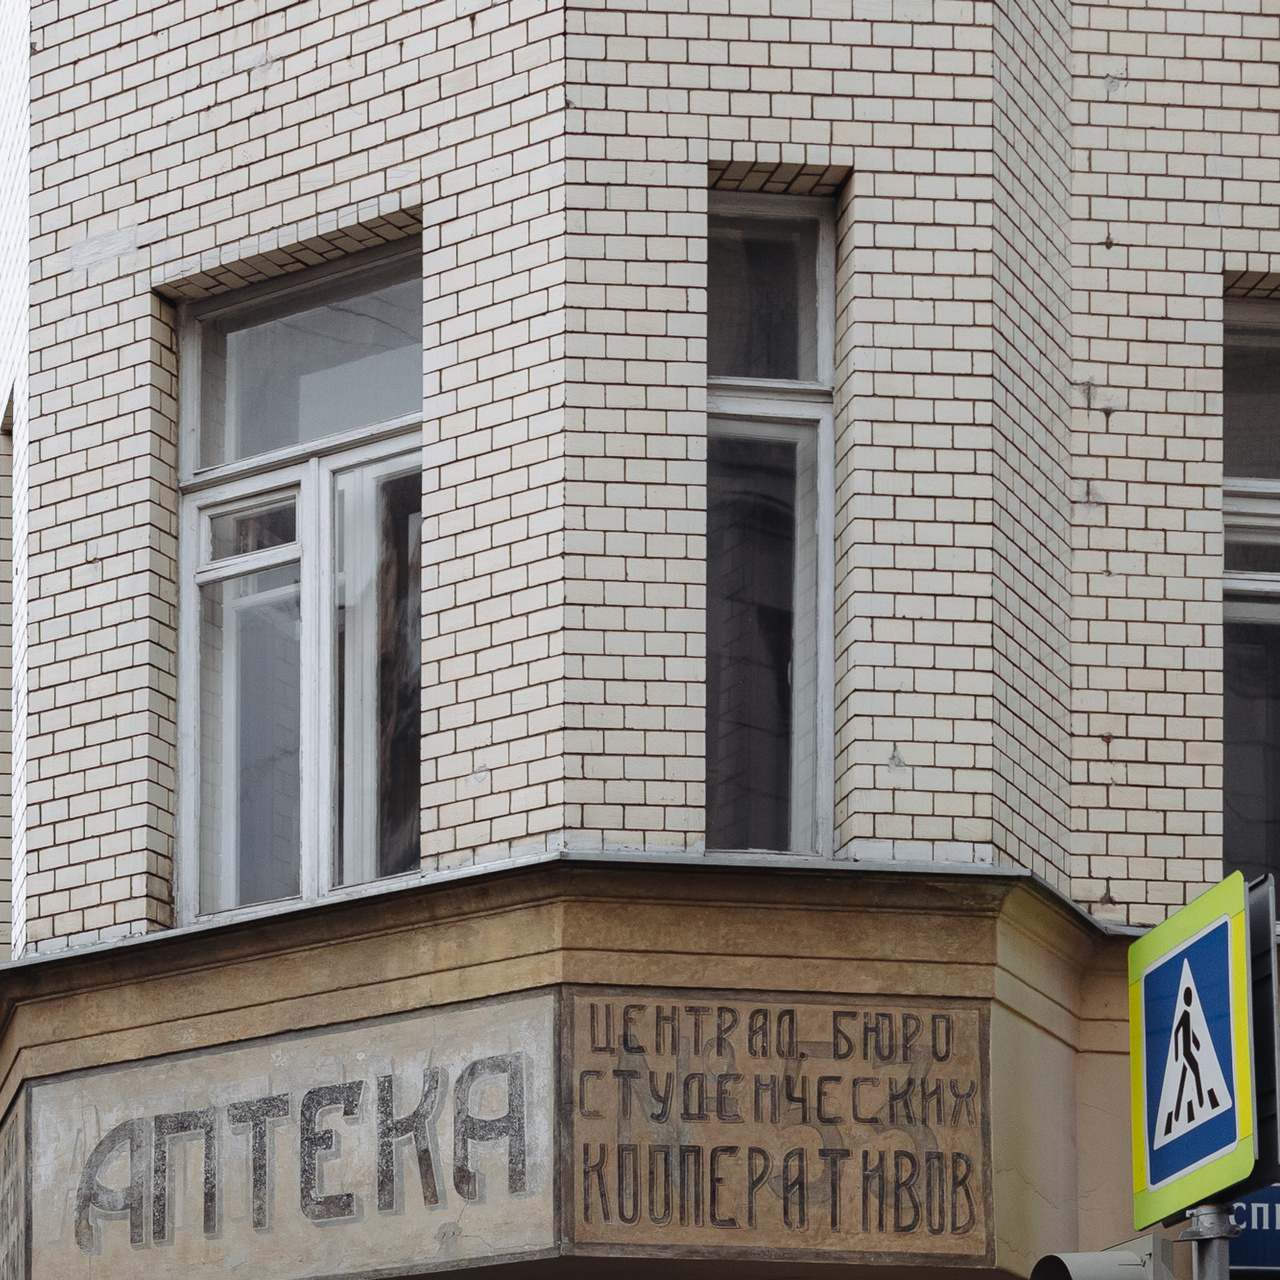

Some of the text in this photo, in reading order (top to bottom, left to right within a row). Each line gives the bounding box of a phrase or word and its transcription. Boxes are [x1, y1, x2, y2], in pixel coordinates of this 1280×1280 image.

[832, 1010, 954, 1063] БЮРО
[578, 1068, 978, 1127] СТУДЕНЧЕСКИХ
[74, 1051, 533, 1257] АПТЕКА
[582, 1142, 977, 1236] КООПЕРАТИВОВ
[1228, 1202, 1280, 1230] СП
